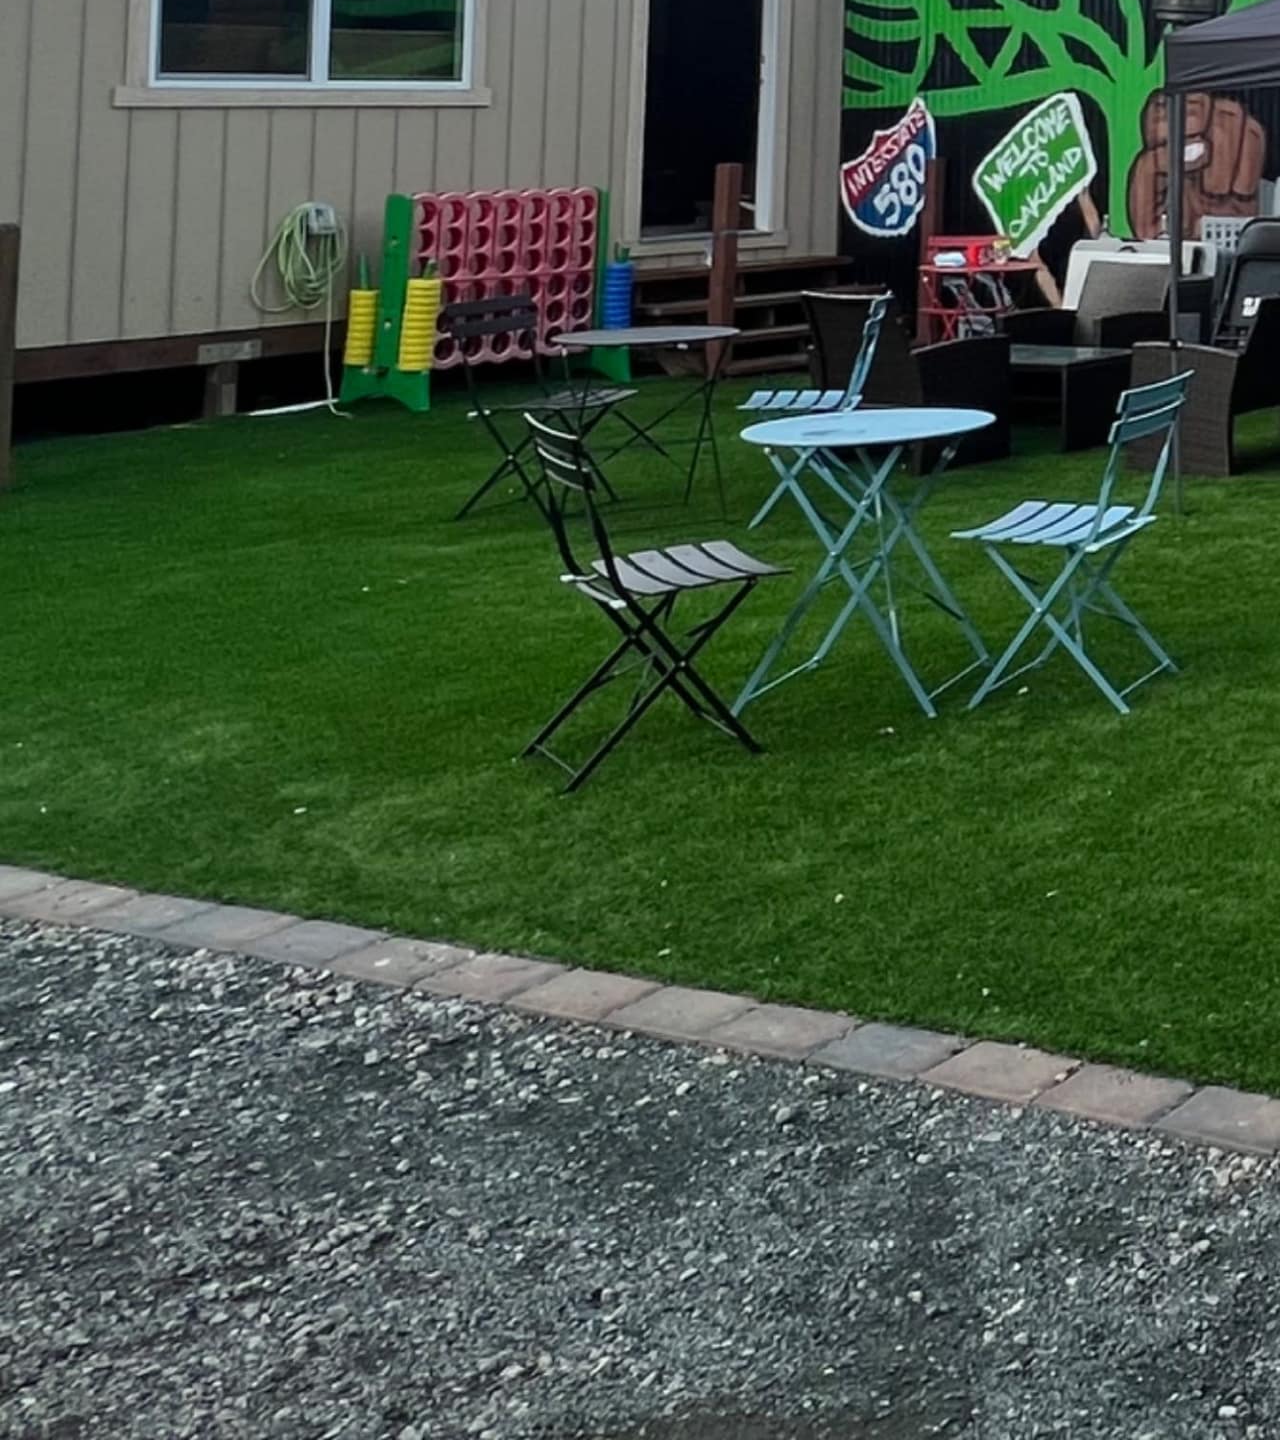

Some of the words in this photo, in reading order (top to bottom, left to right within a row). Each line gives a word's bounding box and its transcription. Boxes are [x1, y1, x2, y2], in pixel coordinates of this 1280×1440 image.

[872, 143, 926, 228] 580
[983, 104, 1073, 194] WELCOME
[1008, 146, 1082, 239] OAKLAND
[1019, 151, 1050, 177] TO
